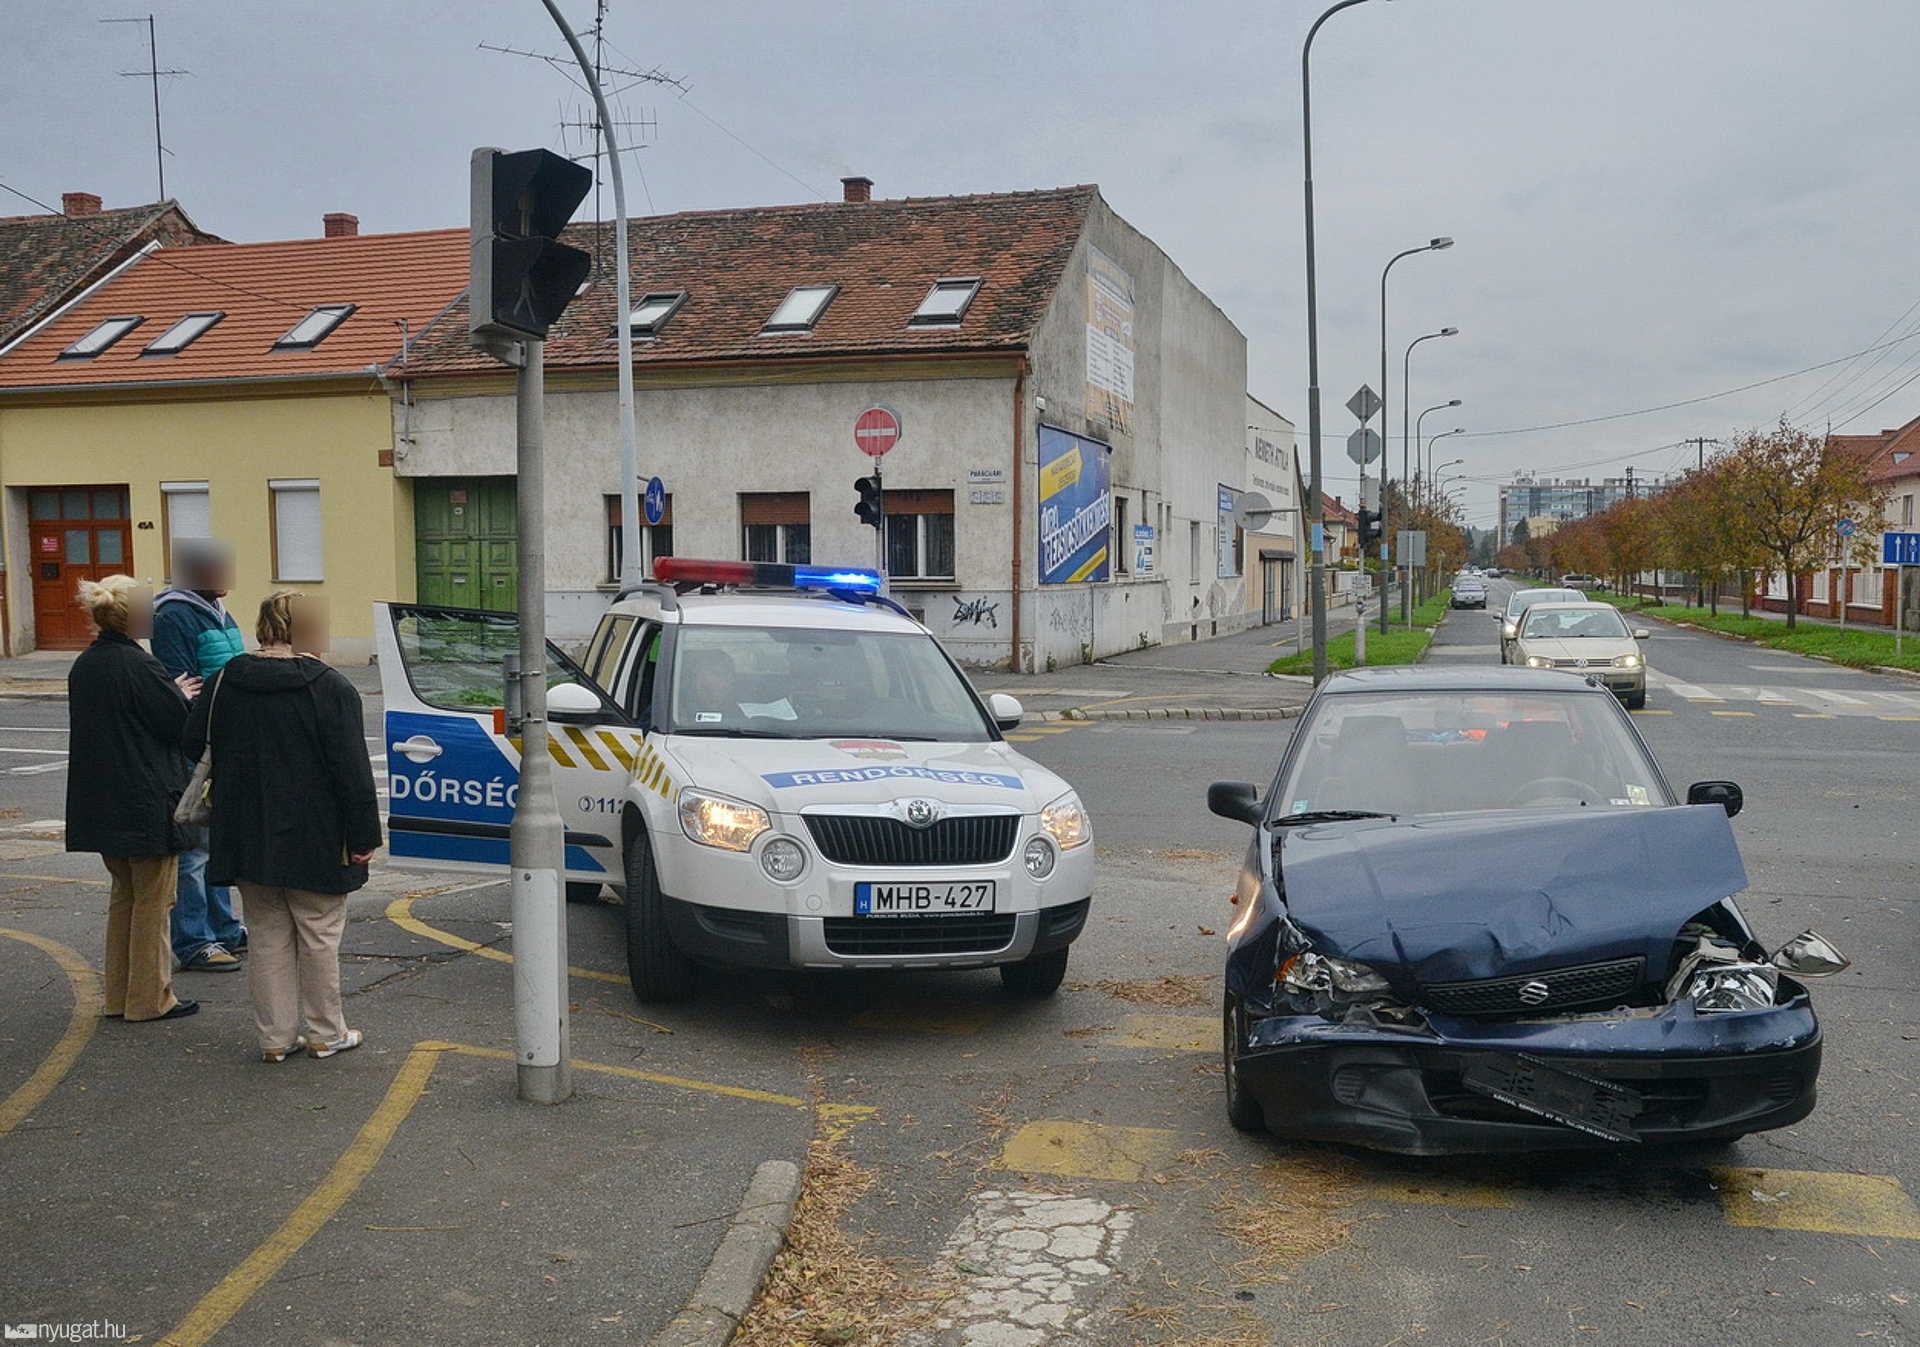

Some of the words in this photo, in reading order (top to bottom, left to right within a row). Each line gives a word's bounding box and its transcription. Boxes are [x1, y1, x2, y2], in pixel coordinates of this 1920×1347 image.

[792, 766, 1005, 786] RENDŐRSÉG
[860, 900, 868, 910] H
[877, 885, 988, 910] MHB-427
